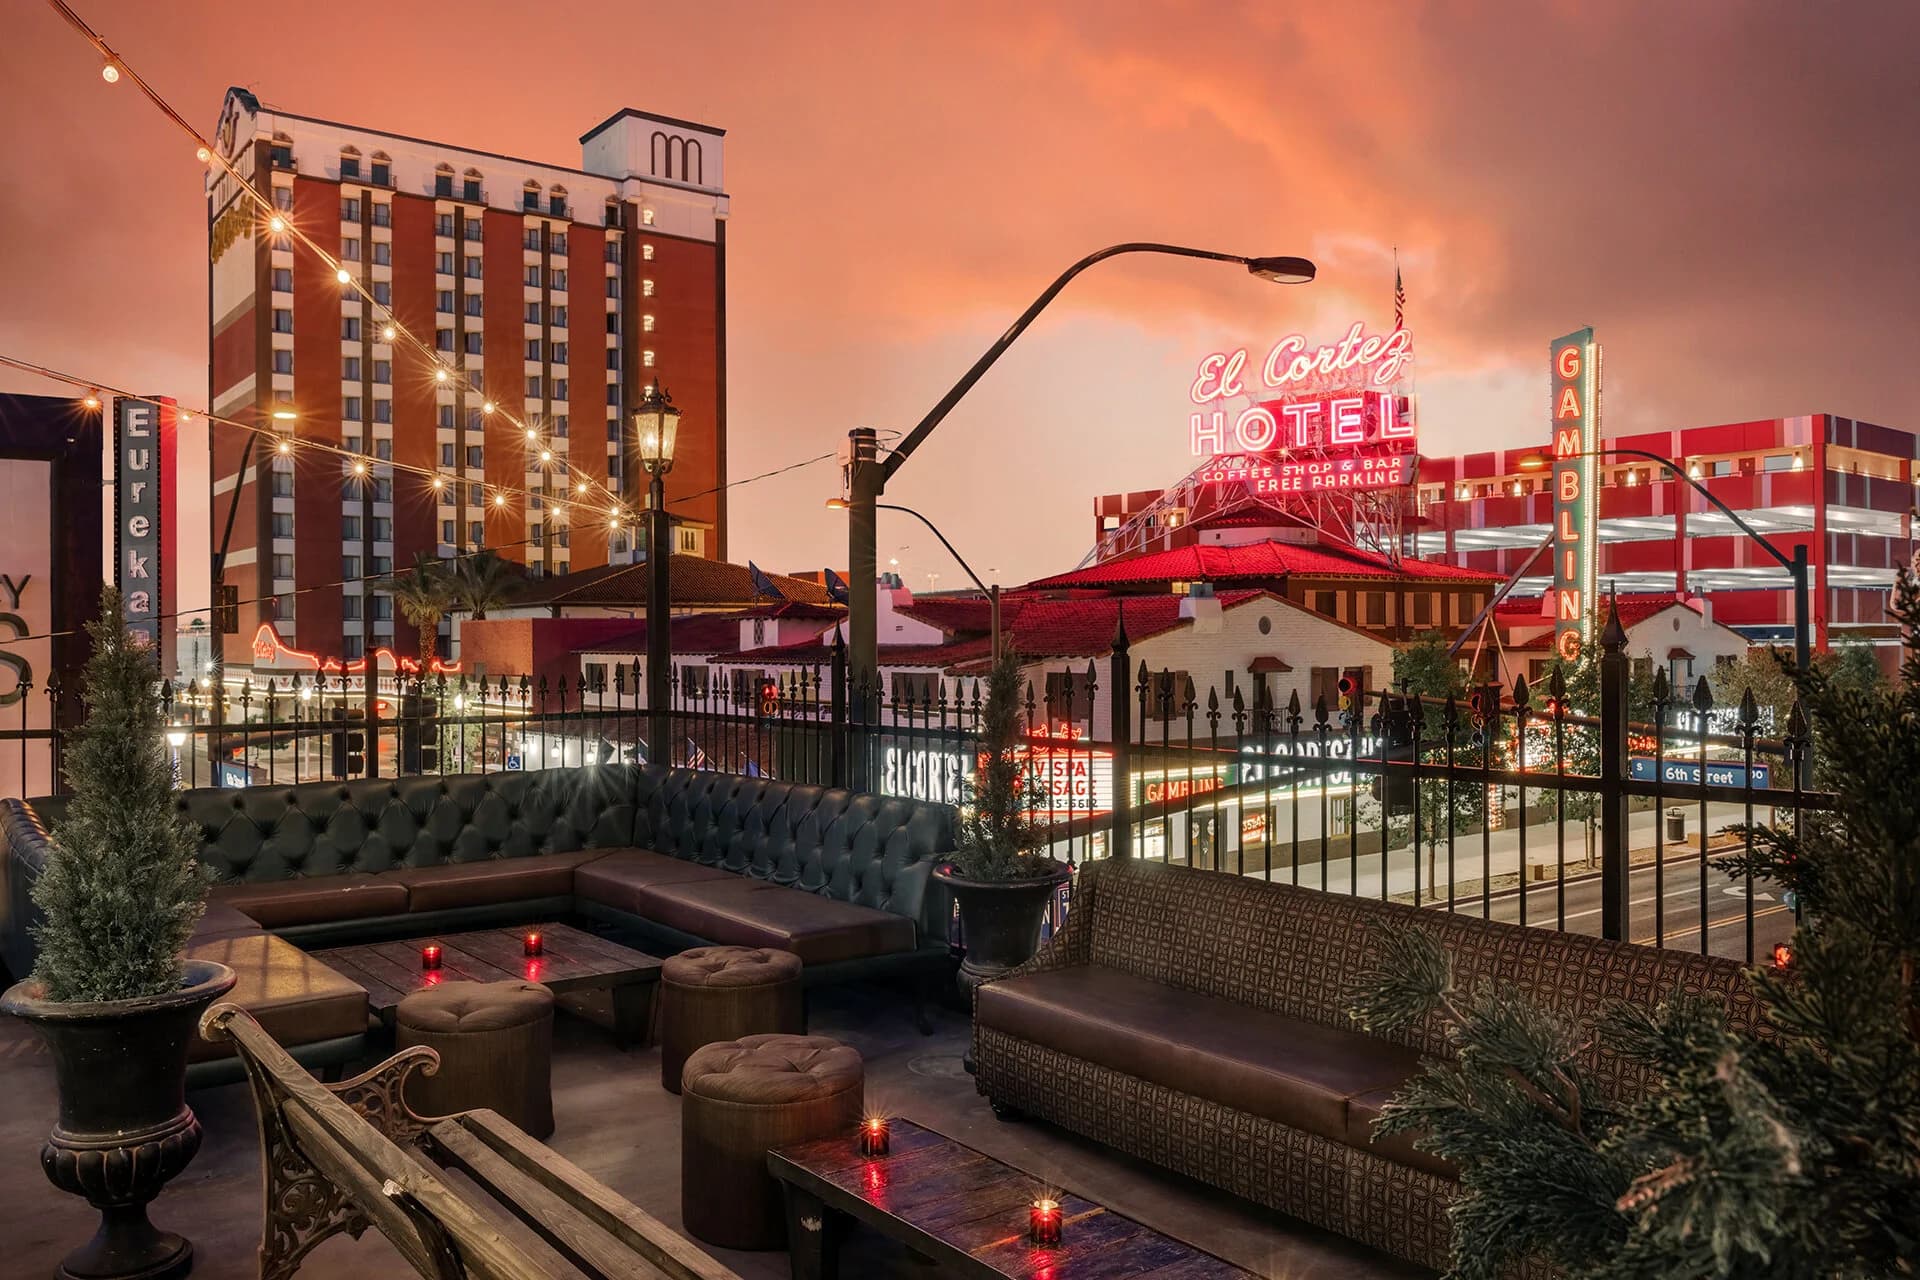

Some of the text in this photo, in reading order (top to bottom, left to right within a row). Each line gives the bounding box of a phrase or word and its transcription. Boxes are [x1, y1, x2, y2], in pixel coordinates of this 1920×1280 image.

[1191, 322, 1413, 403] El Cortez
[1191, 393, 1416, 456] HOTEL
[1202, 457, 1401, 482] COFFEE SHOP & BAR
[1257, 470, 1400, 493] FREE PARKING
[1557, 347, 1582, 662] GAMBLING
[1054, 761, 1087, 777] SPA
[1636, 762, 1643, 772] S
[1665, 767, 1689, 781] 6th
[1693, 768, 1734, 785] Sreet
